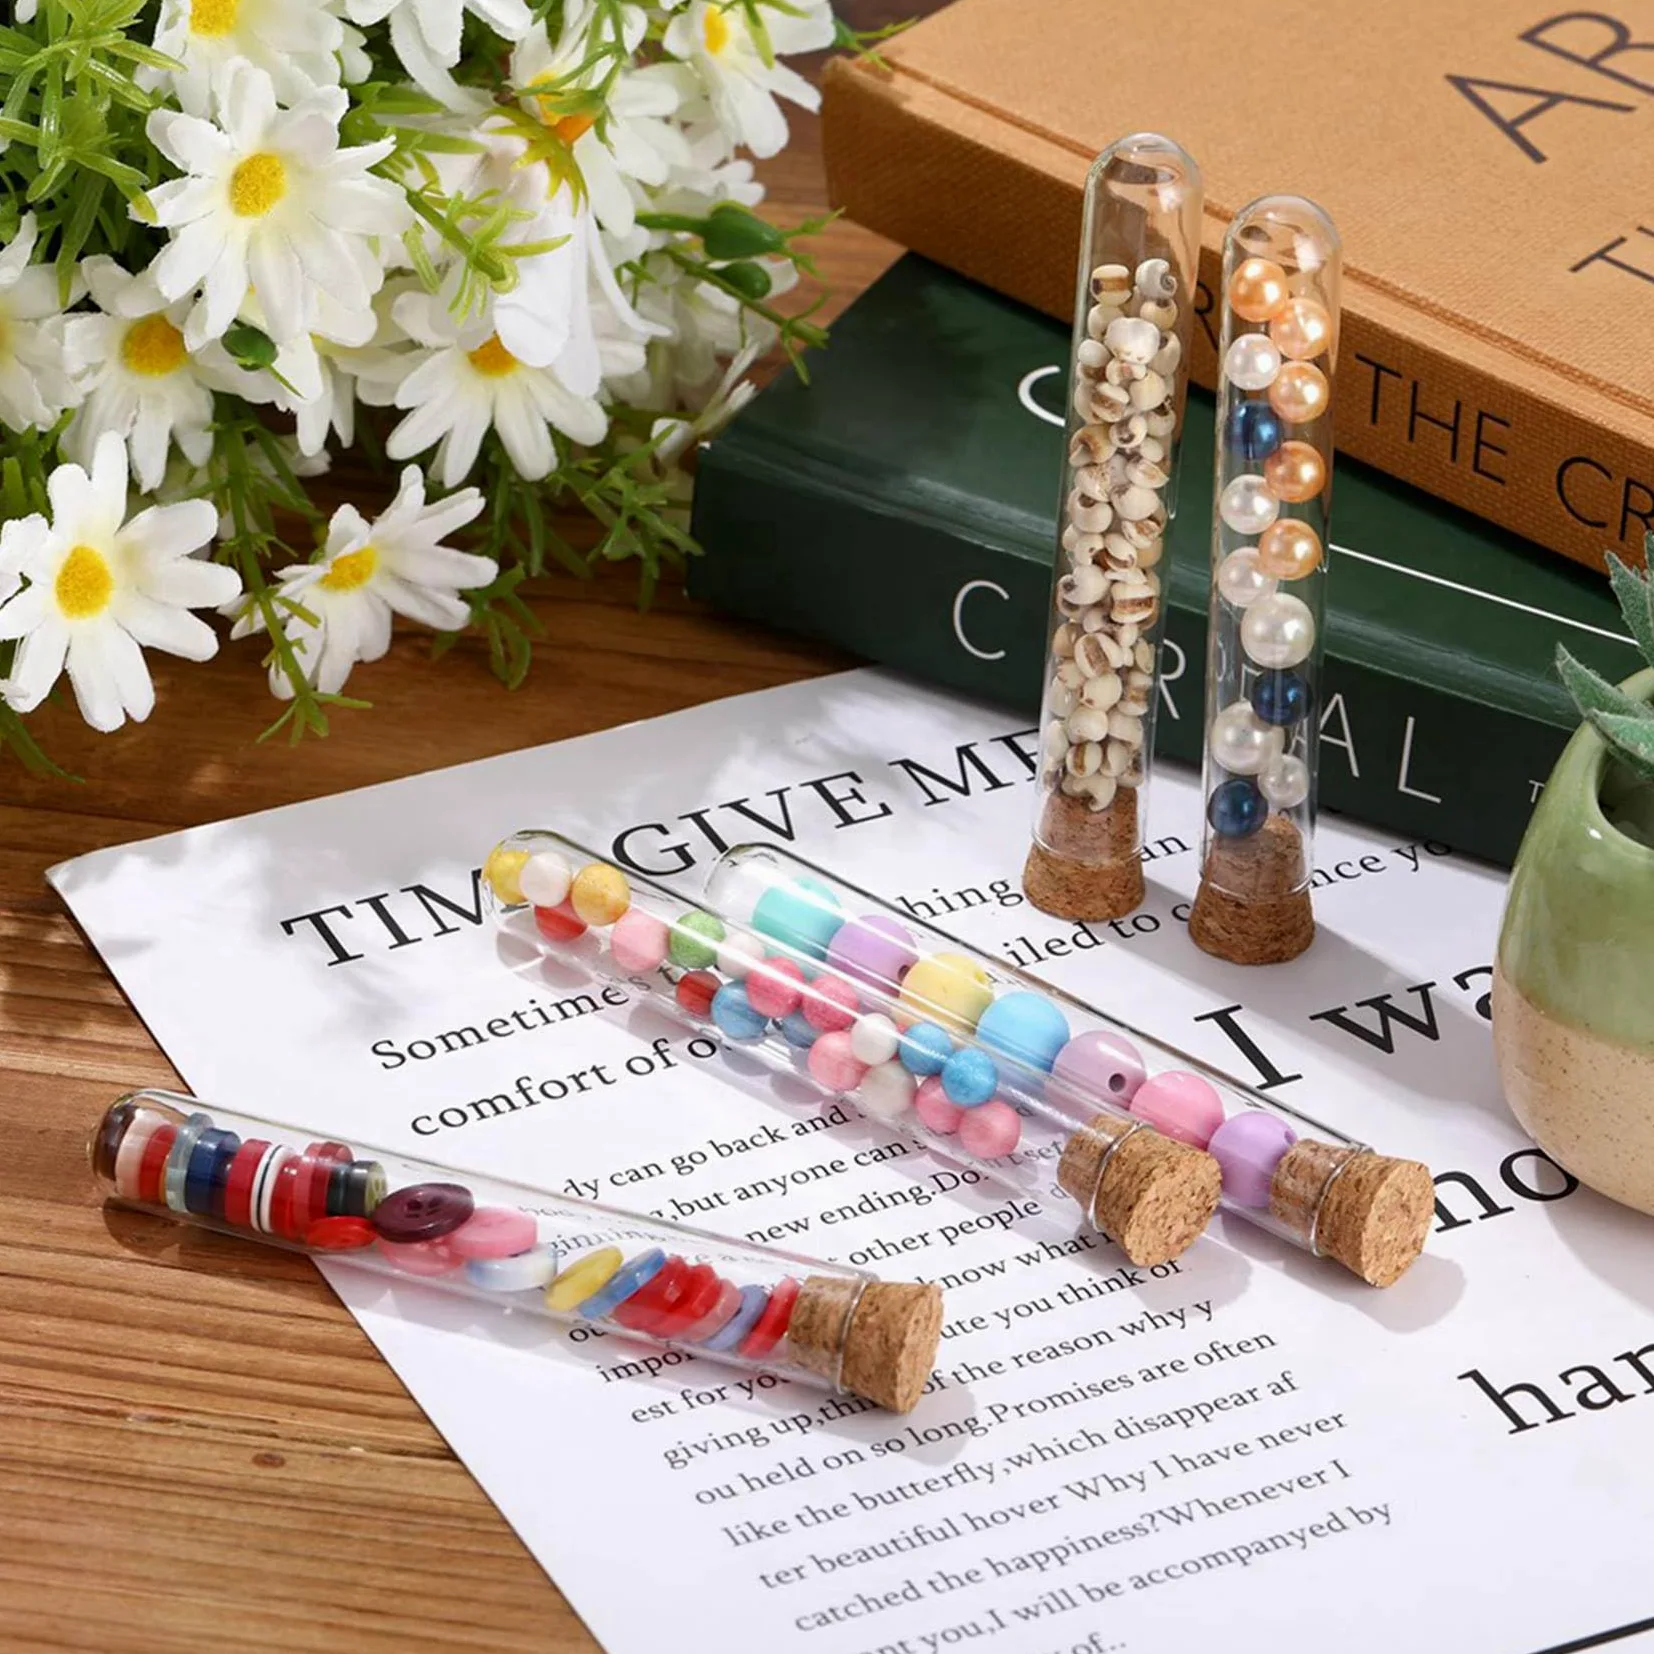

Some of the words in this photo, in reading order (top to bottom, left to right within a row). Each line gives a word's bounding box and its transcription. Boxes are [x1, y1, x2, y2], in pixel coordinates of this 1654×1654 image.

[1355, 352, 1512, 486] THE
[1556, 455, 1654, 542] CR
[280, 868, 484, 967] TIM
[611, 771, 893, 877] GIVE
[895, 878, 1024, 919] hing
[1141, 834, 1192, 863] an
[1310, 854, 1387, 889] nce
[1394, 836, 1453, 872] yo
[410, 1058, 618, 1137] comfort
[625, 1036, 677, 1077] of
[1004, 920, 1104, 968] iled
[1107, 912, 1161, 940] to
[1193, 1004, 1303, 1091] I
[608, 1161, 665, 1187] can
[670, 1150, 708, 1176] go
[706, 1124, 790, 1158] back
[793, 1105, 851, 1137] and
[735, 1157, 850, 1203] anyone
[853, 1140, 909, 1167] can
[745, 1216, 823, 1245] new
[818, 1169, 990, 1226] ending.Do
[848, 1231, 930, 1266] other
[937, 1198, 1043, 1240] people
[1015, 1233, 1098, 1267] what
[630, 1402, 679, 1424] est
[681, 1388, 731, 1410] for
[940, 1315, 989, 1340] ute
[992, 1296, 1054, 1330] you
[1056, 1266, 1148, 1306] think
[662, 1424, 770, 1471] giving
[918, 1372, 948, 1396] of
[951, 1356, 1017, 1388] the
[1011, 1327, 1116, 1370] reason
[1118, 1305, 1186, 1338] why
[1194, 1298, 1214, 1322] y
[694, 1480, 739, 1506] ou
[740, 1456, 818, 1495] held
[823, 1448, 867, 1472] on
[869, 1436, 907, 1458] so
[1137, 1356, 1190, 1384] are
[1193, 1332, 1279, 1367] often
[720, 1517, 791, 1548] like
[794, 1500, 852, 1529] the
[1112, 1384, 1262, 1443] disappear
[1266, 1369, 1302, 1397] af
[758, 1565, 807, 1590] ter
[809, 1517, 963, 1575] beautiful
[964, 1493, 1074, 1533] hover
[1062, 1468, 1149, 1504] Why
[1150, 1459, 1172, 1481] I
[1167, 1441, 1252, 1475] have
[1255, 1412, 1349, 1452] never
[794, 1578, 925, 1633] catched
[926, 1568, 986, 1596] the
[1329, 1458, 1352, 1480] I
[1010, 1587, 1082, 1623] will
[1077, 1580, 1126, 1604] be
[1127, 1512, 1351, 1591] accompanyed
[1344, 1498, 1395, 1529] by
